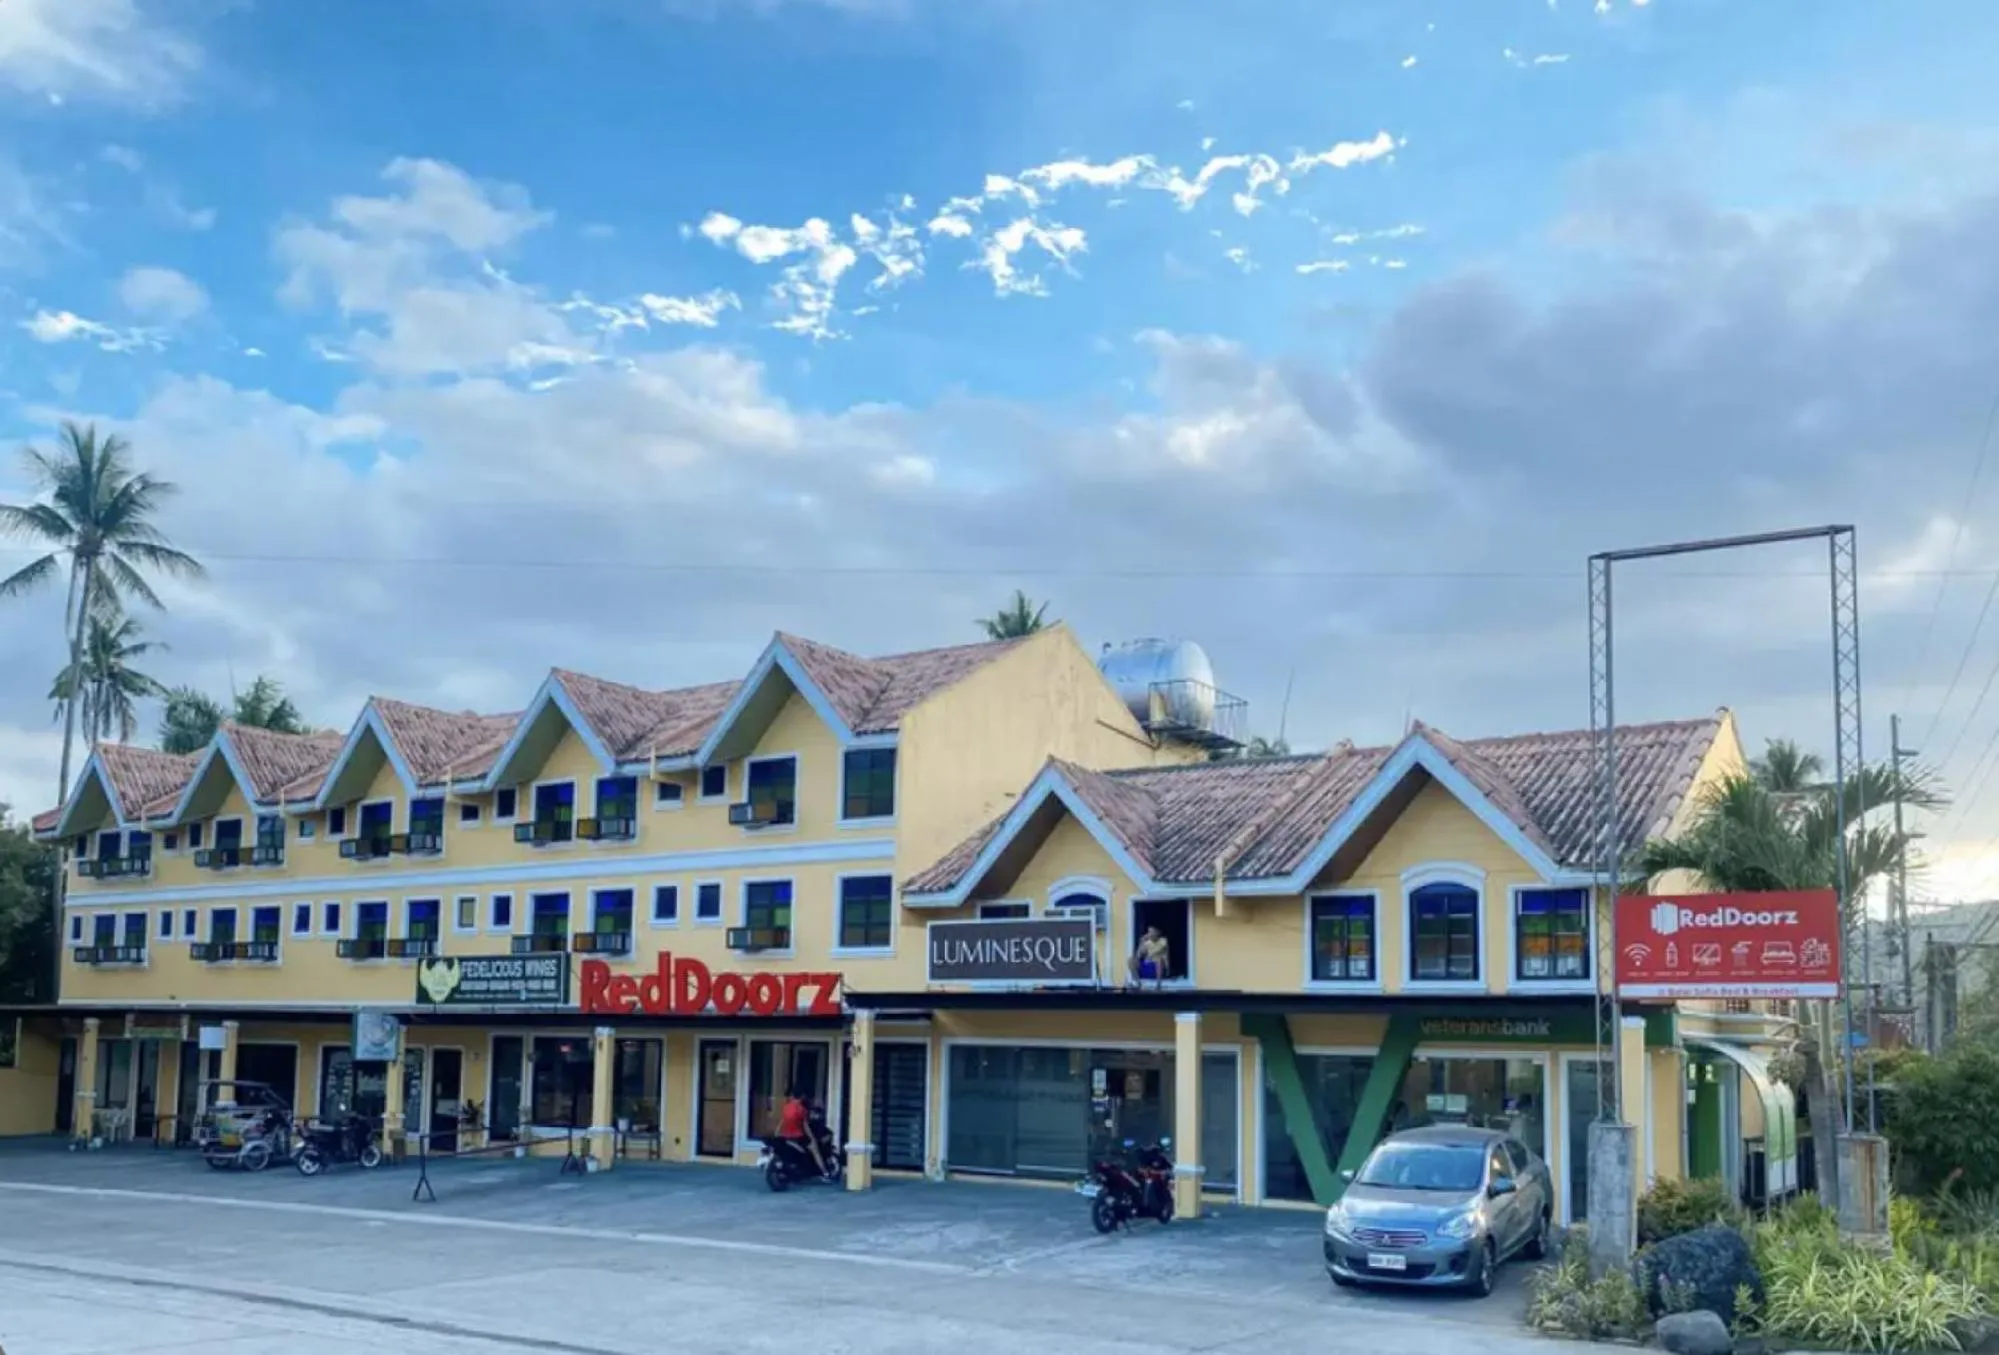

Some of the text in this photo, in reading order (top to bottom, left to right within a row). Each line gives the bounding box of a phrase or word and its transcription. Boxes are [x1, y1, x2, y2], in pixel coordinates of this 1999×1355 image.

[1680, 907, 1798, 927] RedDoorz
[933, 937, 1086, 971] LUMINESQUE
[580, 951, 842, 1016] RedDoorz
